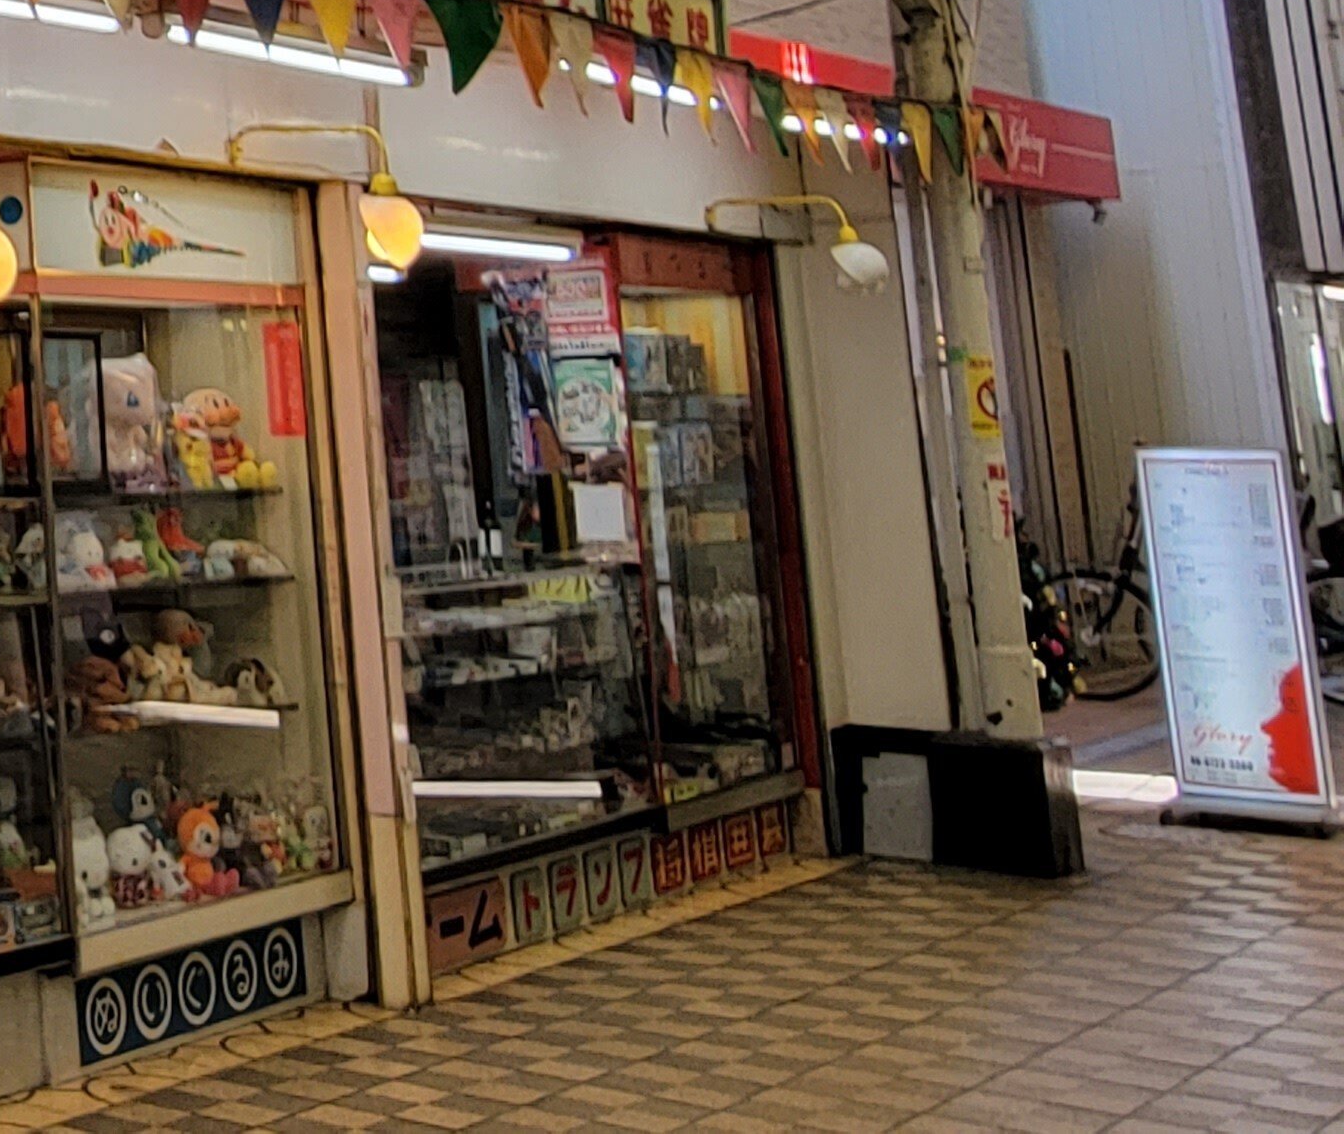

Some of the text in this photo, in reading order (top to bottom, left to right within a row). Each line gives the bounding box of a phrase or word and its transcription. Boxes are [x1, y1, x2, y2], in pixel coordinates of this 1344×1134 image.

[94, 939, 294, 1037] ぬいぐるみ
